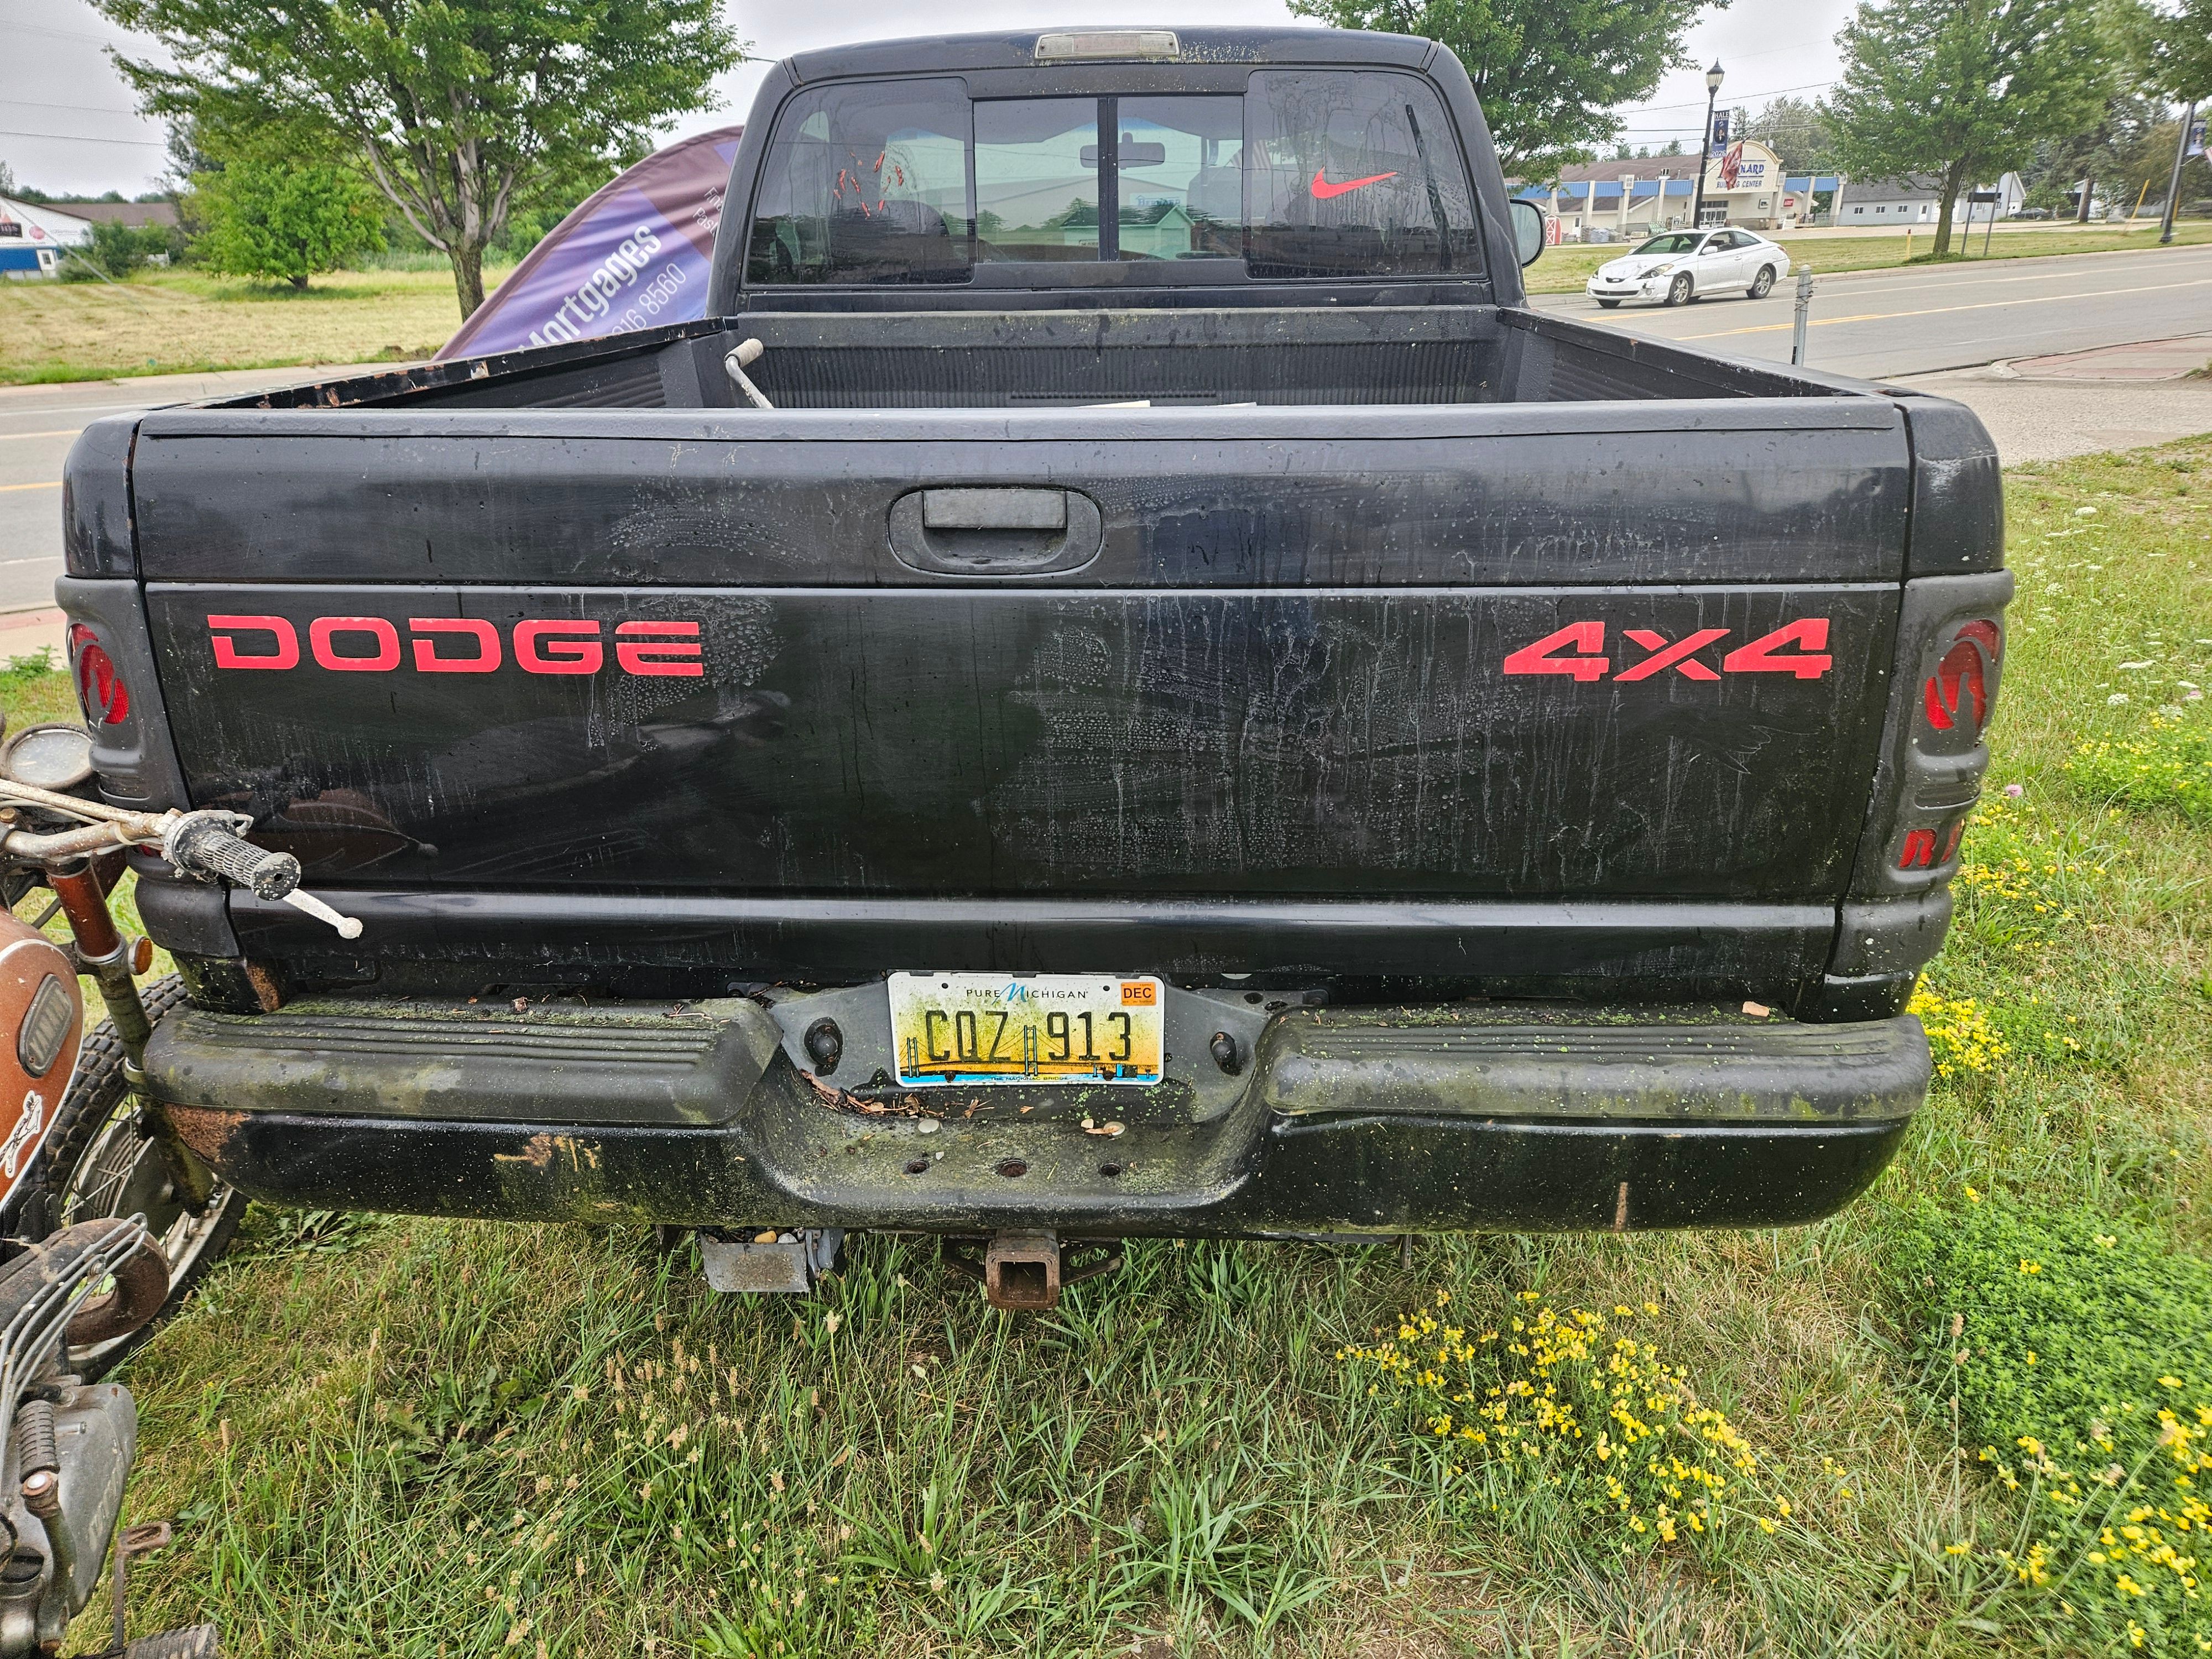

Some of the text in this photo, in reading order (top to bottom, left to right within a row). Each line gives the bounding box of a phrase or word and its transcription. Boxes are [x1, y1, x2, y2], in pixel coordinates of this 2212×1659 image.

[639, 263, 686, 315] 8560
[207, 614, 703, 676] DODGE
[966, 982, 1087, 1006] PURE MICHIGAN
[1123, 988, 1152, 999] DEC
[925, 1010, 1131, 1062] CQZ 913
